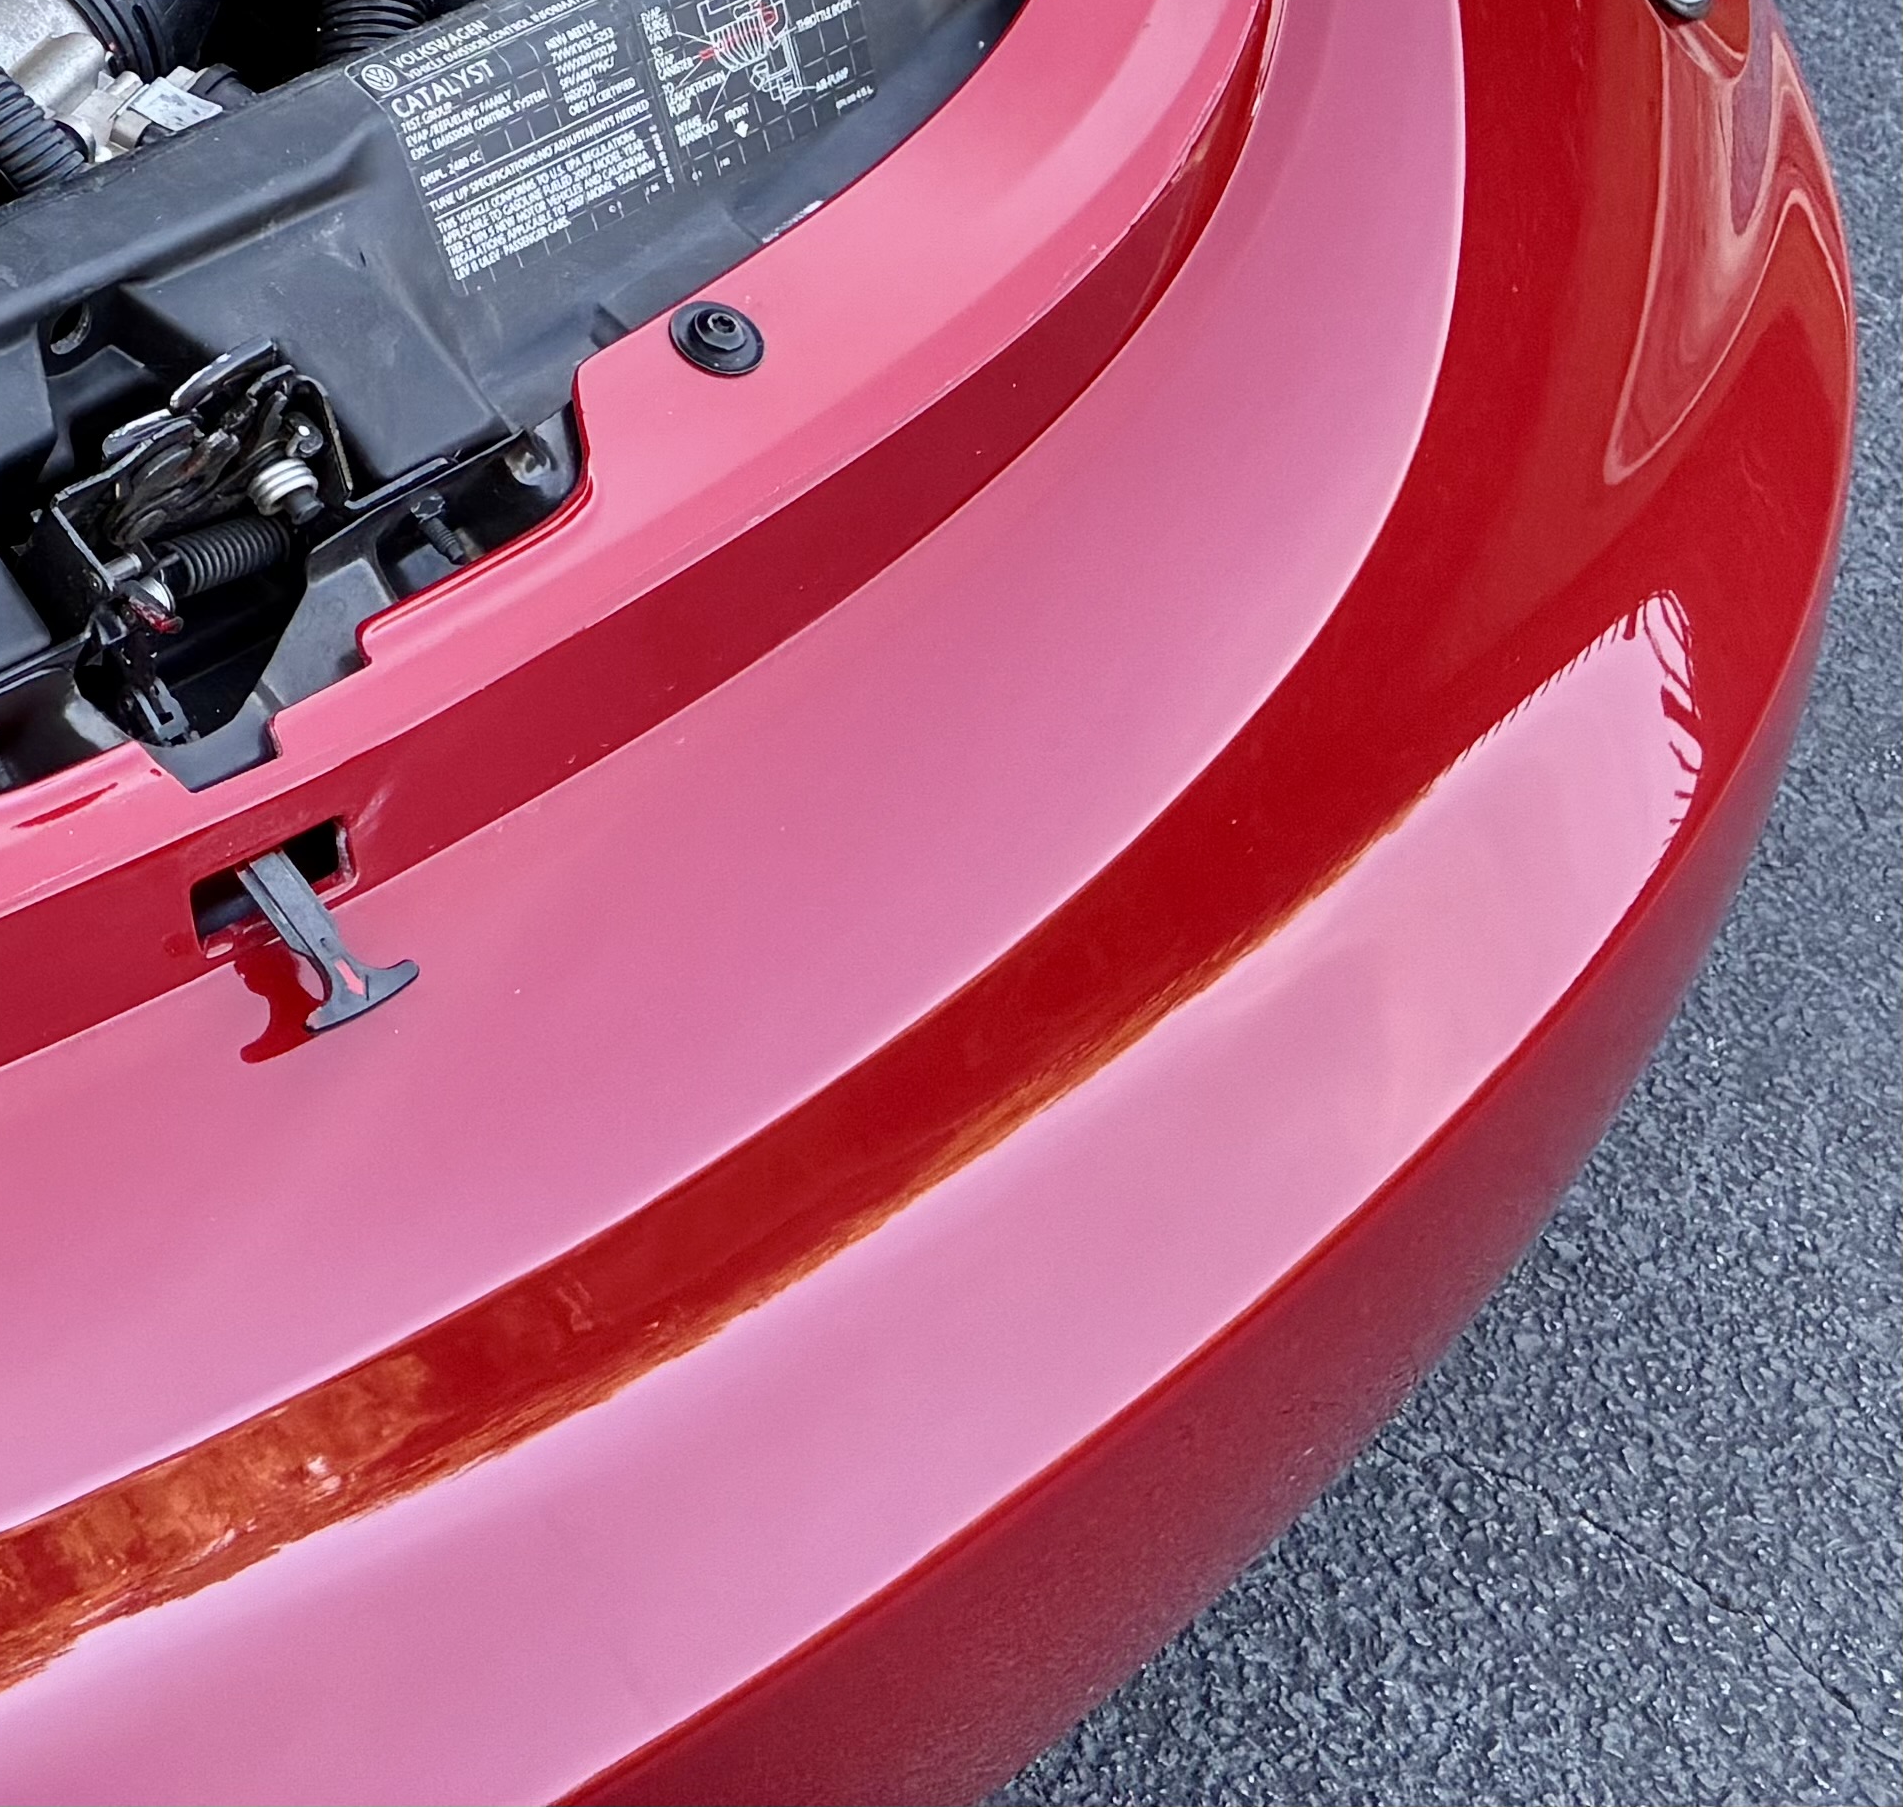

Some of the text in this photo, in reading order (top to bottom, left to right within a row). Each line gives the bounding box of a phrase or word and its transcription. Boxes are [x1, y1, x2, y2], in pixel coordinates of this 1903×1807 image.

[389, 19, 490, 69] VOLKSWAGEN
[488, 16, 535, 43] CONTROL
[545, 19, 599, 51] NEW BEETLE
[391, 59, 495, 119] CATALYST
[474, 105, 515, 131] CONTROL
[513, 88, 549, 113] SYSTEM
[479, 89, 512, 113] FAMILY
[401, 101, 455, 134] TEST GROUP
[429, 191, 457, 212] TUNE
[454, 185, 470, 201] UP
[551, 115, 616, 155] ADJUSTMENTS
[614, 99, 650, 124] NEEDED
[437, 216, 458, 234] THIS
[456, 200, 492, 224] VEHICLE
[491, 177, 538, 209] CONFORMS
[536, 172, 550, 186] TO
[565, 156, 583, 172] EPA
[582, 129, 637, 164] REGULATIONS
[469, 150, 483, 164] CC
[443, 138, 646, 247] APPLICABLE TO GASOLINE FUELED 2007 MODEL YEAR
[445, 241, 466, 257] TIER
[494, 215, 516, 234] NEW
[516, 200, 547, 224] MOTOR
[546, 181, 584, 208] VEHICLES
[584, 173, 603, 190] AND
[602, 150, 650, 181] CALIFORNIA
[450, 232, 507, 269] REGULATIONS
[507, 210, 554, 242] APPLICABLE
[552, 204, 566, 218] TO
[584, 180, 617, 202] MODEL
[615, 168, 638, 187] YEAR
[636, 158, 657, 177] NEW
[454, 263, 471, 281] LEV
[503, 226, 550, 257] PASSENGER
